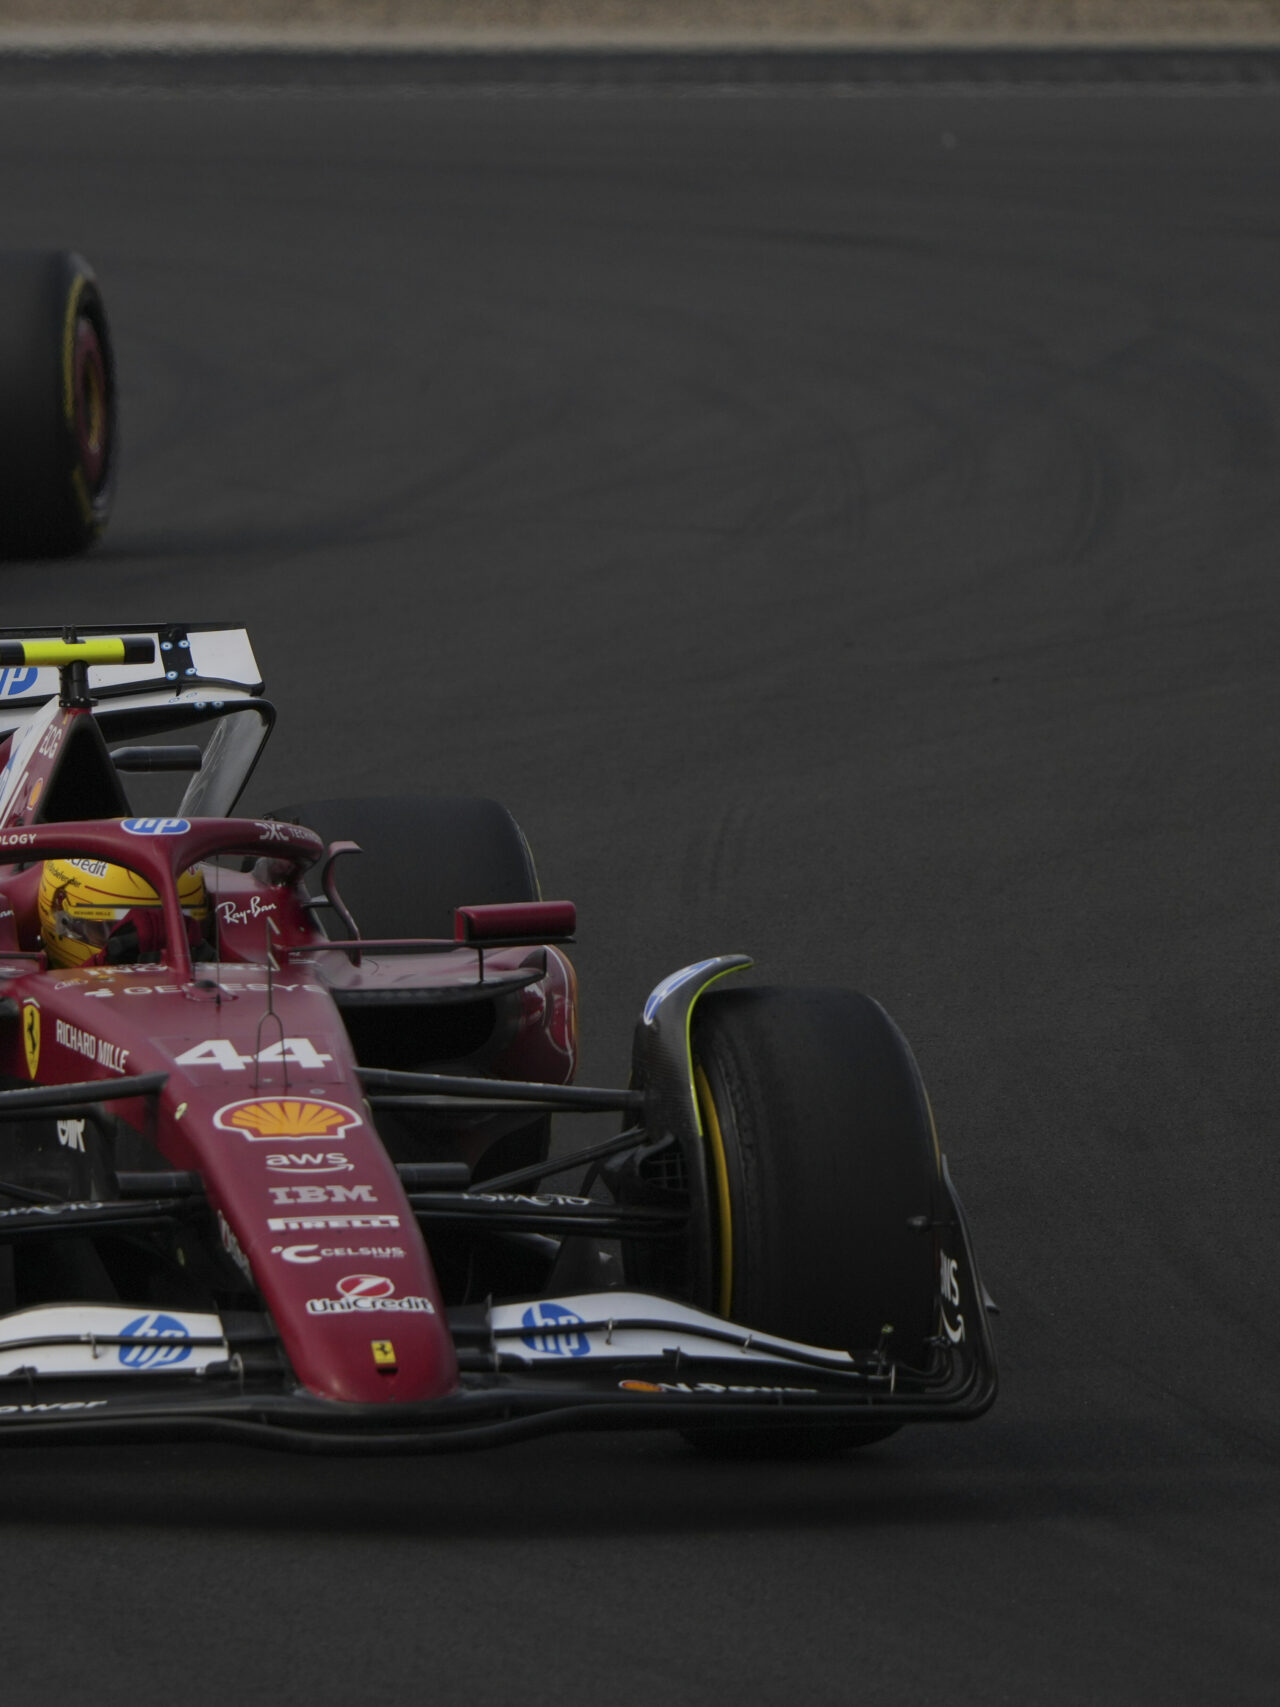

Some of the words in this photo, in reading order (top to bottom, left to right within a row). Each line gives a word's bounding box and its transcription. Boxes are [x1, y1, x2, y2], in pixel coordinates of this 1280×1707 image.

[128, 817, 185, 835] hp
[215, 895, 278, 925] Ray-Ban
[55, 1018, 97, 1062] RICHARD
[97, 1038, 130, 1074] MILLE
[174, 1037, 333, 1071] 44
[265, 1152, 353, 1170] aws
[268, 1184, 378, 1205] IBM
[267, 1214, 400, 1231] PIRELLI
[320, 1246, 404, 1258] CELSIUS
[305, 1295, 435, 1314] UniCredit
[522, 1303, 588, 1357] hp
[121, 1314, 188, 1369] hp
